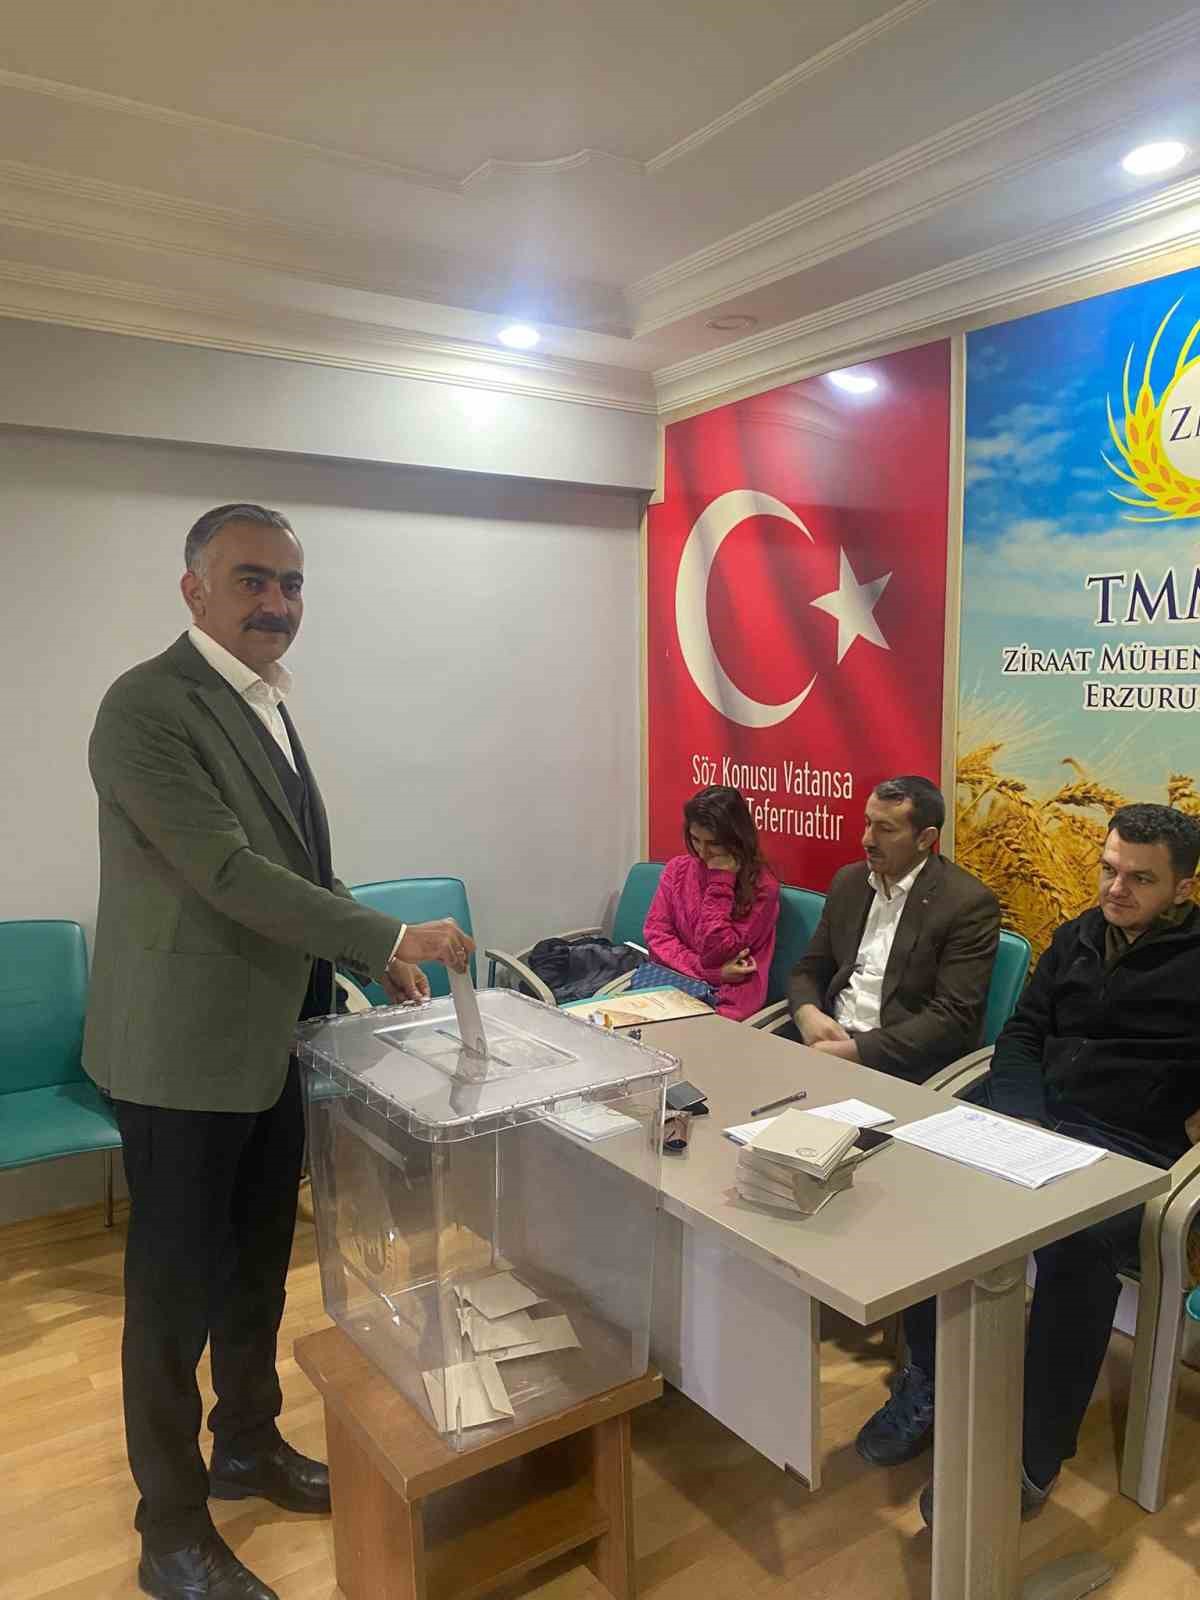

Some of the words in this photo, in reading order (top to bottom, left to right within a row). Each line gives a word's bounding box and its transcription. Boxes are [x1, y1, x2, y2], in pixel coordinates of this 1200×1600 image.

[1169, 405, 1200, 441] Z
[1087, 567, 1200, 624] TM
[1003, 645, 1093, 672] ZİRAAT
[692, 754, 717, 786] Söz
[722, 757, 777, 792] Konusu
[784, 761, 853, 799] Vatansa
